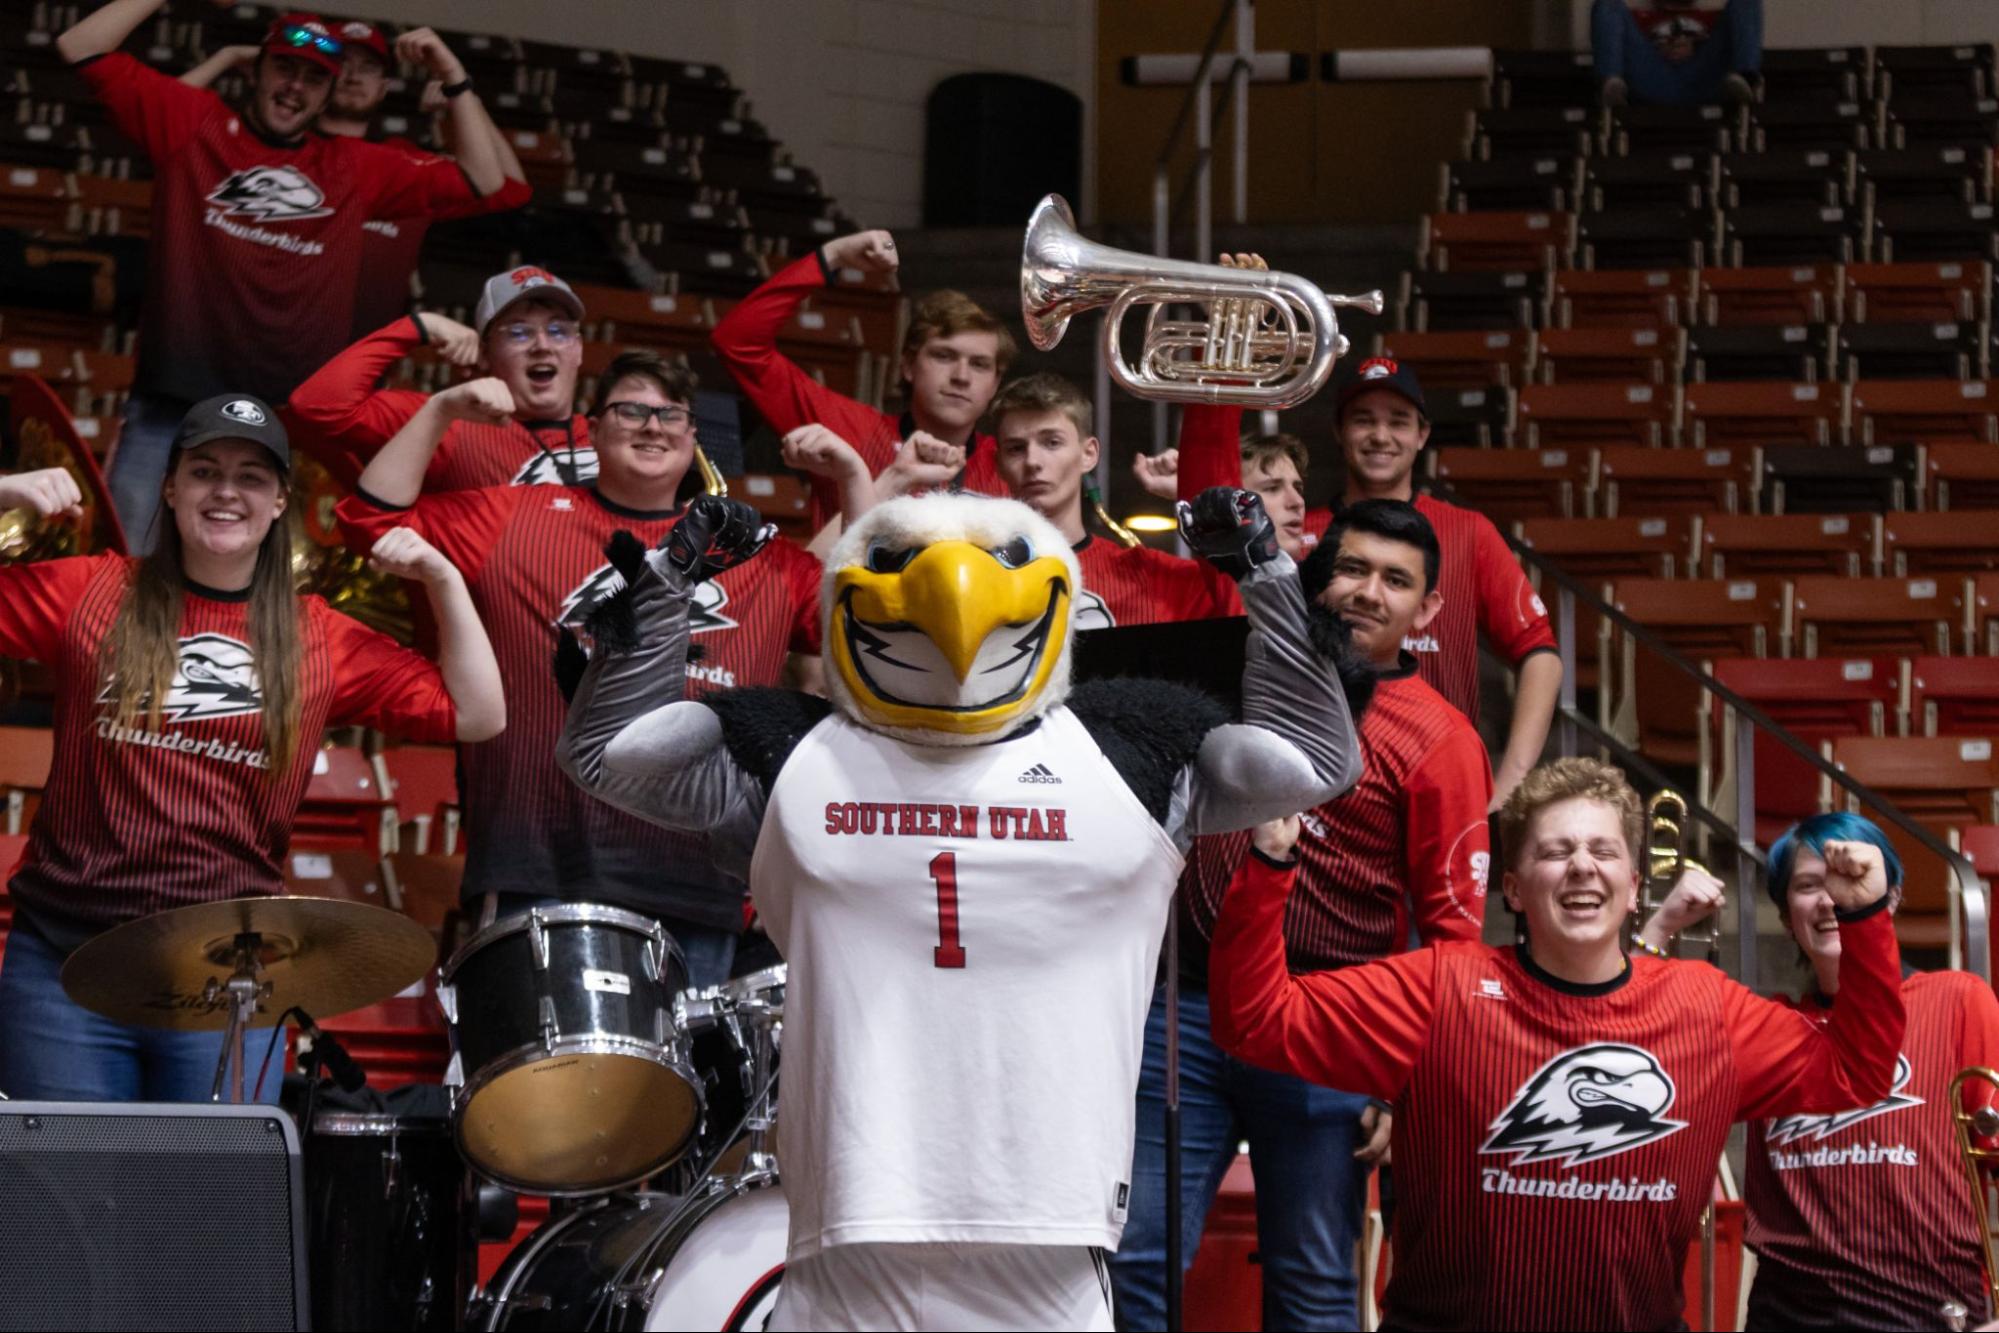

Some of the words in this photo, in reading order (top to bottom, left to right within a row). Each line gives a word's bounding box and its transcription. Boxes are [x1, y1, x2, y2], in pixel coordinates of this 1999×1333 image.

[204, 207, 325, 256] Thunderbirds
[1017, 774, 1063, 785] adidas
[824, 801, 980, 839] SOUTHERN
[988, 806, 1068, 842] UTAH
[929, 851, 966, 968] 1
[1481, 1167, 1677, 1203] Thunderbirds
